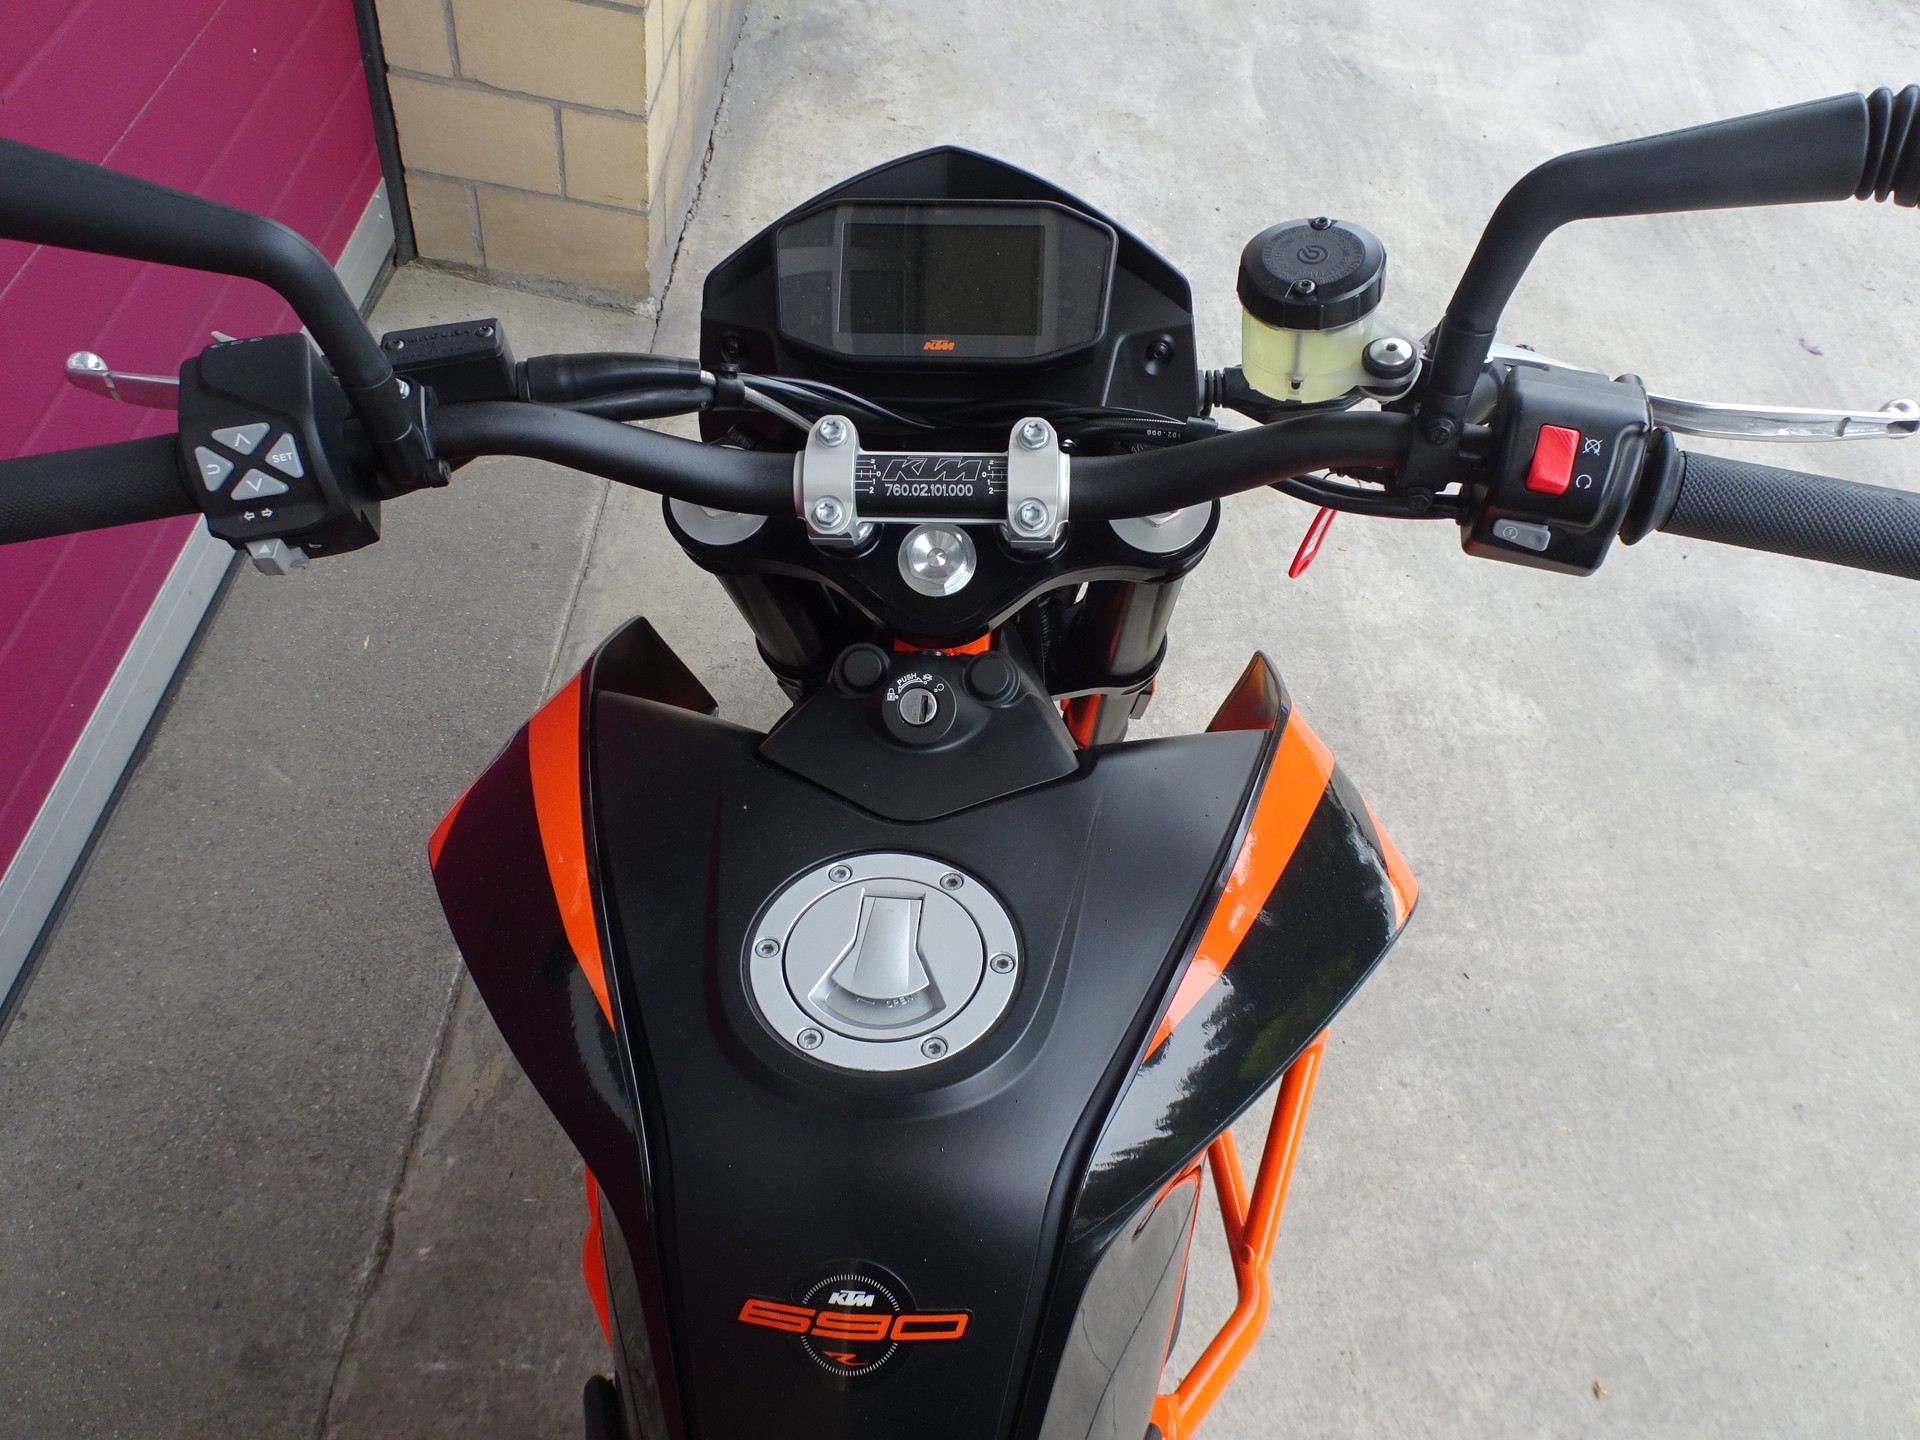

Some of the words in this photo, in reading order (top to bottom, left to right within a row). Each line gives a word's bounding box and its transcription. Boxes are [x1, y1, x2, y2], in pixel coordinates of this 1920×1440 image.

[923, 339, 956, 351] KTM
[272, 452, 293, 463] SET
[882, 456, 983, 482] KTM
[884, 483, 974, 497] 760.02.101.000
[988, 487, 994, 495] 2
[896, 672, 917, 686] PUSH
[827, 1289, 876, 1308] KTM
[737, 1298, 970, 1342] 690
